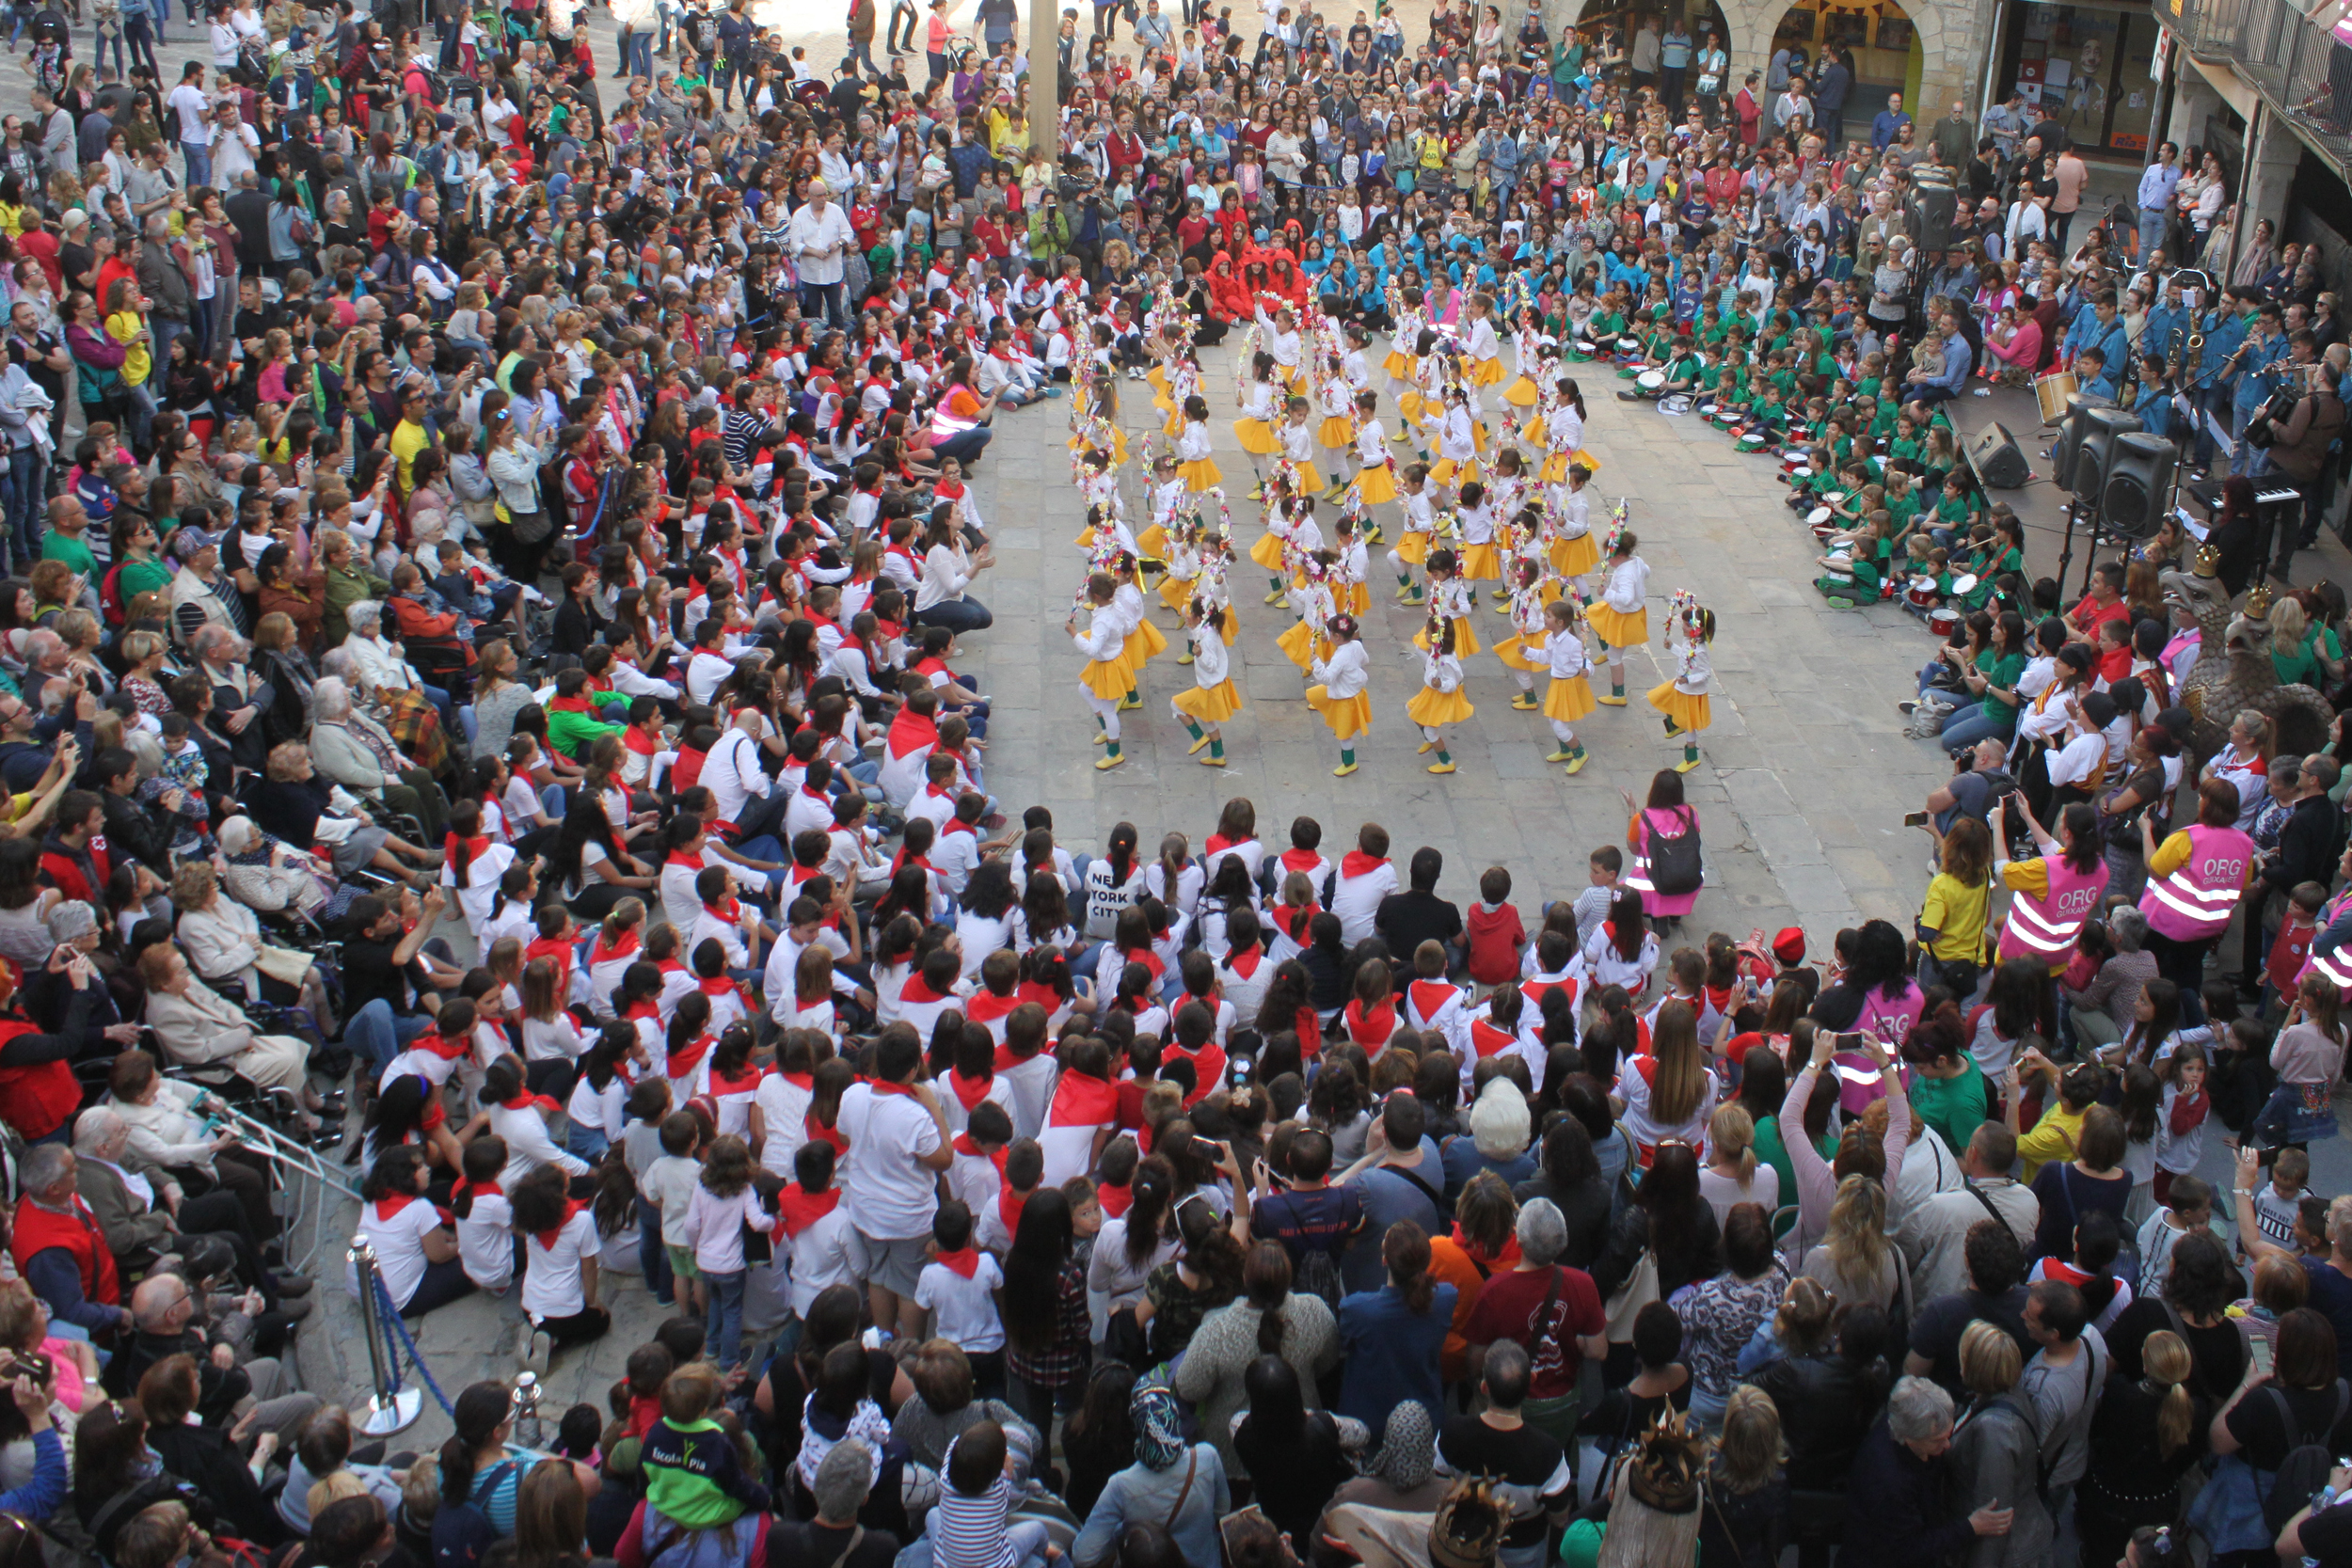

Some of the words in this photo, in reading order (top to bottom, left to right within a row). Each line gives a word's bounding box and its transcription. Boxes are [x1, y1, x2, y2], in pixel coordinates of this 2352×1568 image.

[2203, 858, 2242, 876] ORG
[1091, 889, 1128, 904] YORK
[2058, 885, 2097, 911] ORG
[1092, 905, 1120, 918] CITY
[652, 1446, 682, 1465] Escola
